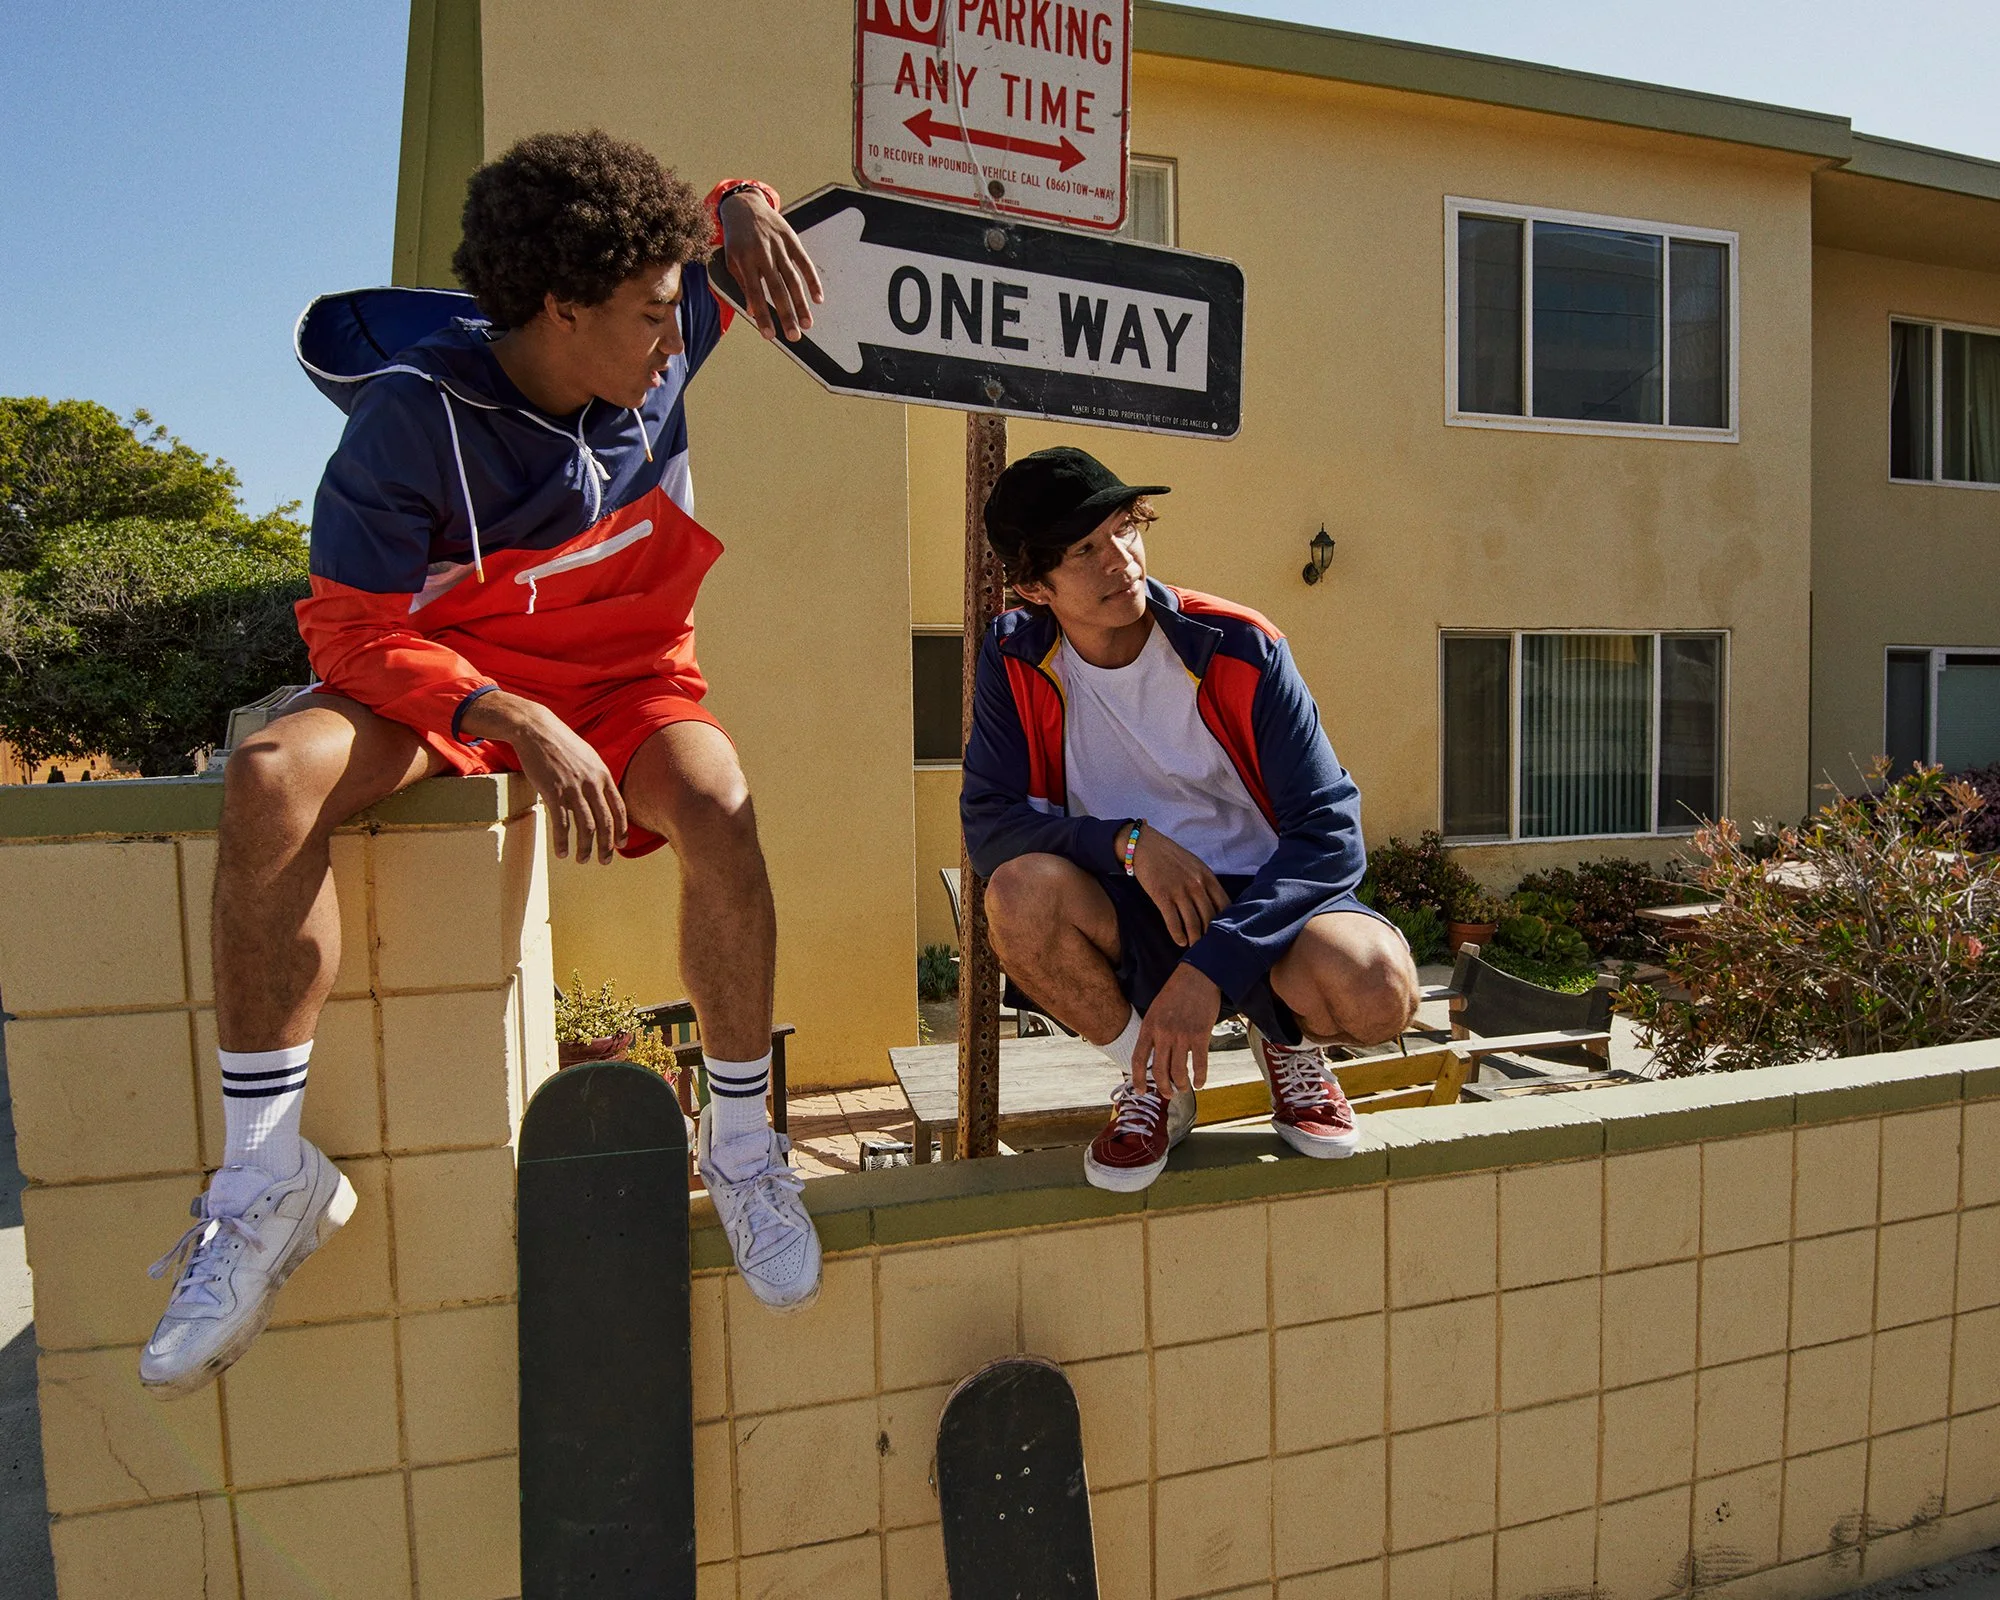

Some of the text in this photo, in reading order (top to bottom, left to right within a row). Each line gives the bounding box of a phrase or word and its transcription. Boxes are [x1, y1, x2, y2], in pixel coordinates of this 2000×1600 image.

[958, 0, 1112, 65] PARKING
[894, 52, 1095, 134] ANY TIME
[868, 144, 1116, 201] TO RECOVER IMPOUNDED VEHICLE CALL (866) TOW-AWAY
[888, 265, 1192, 372] ONE WAY
